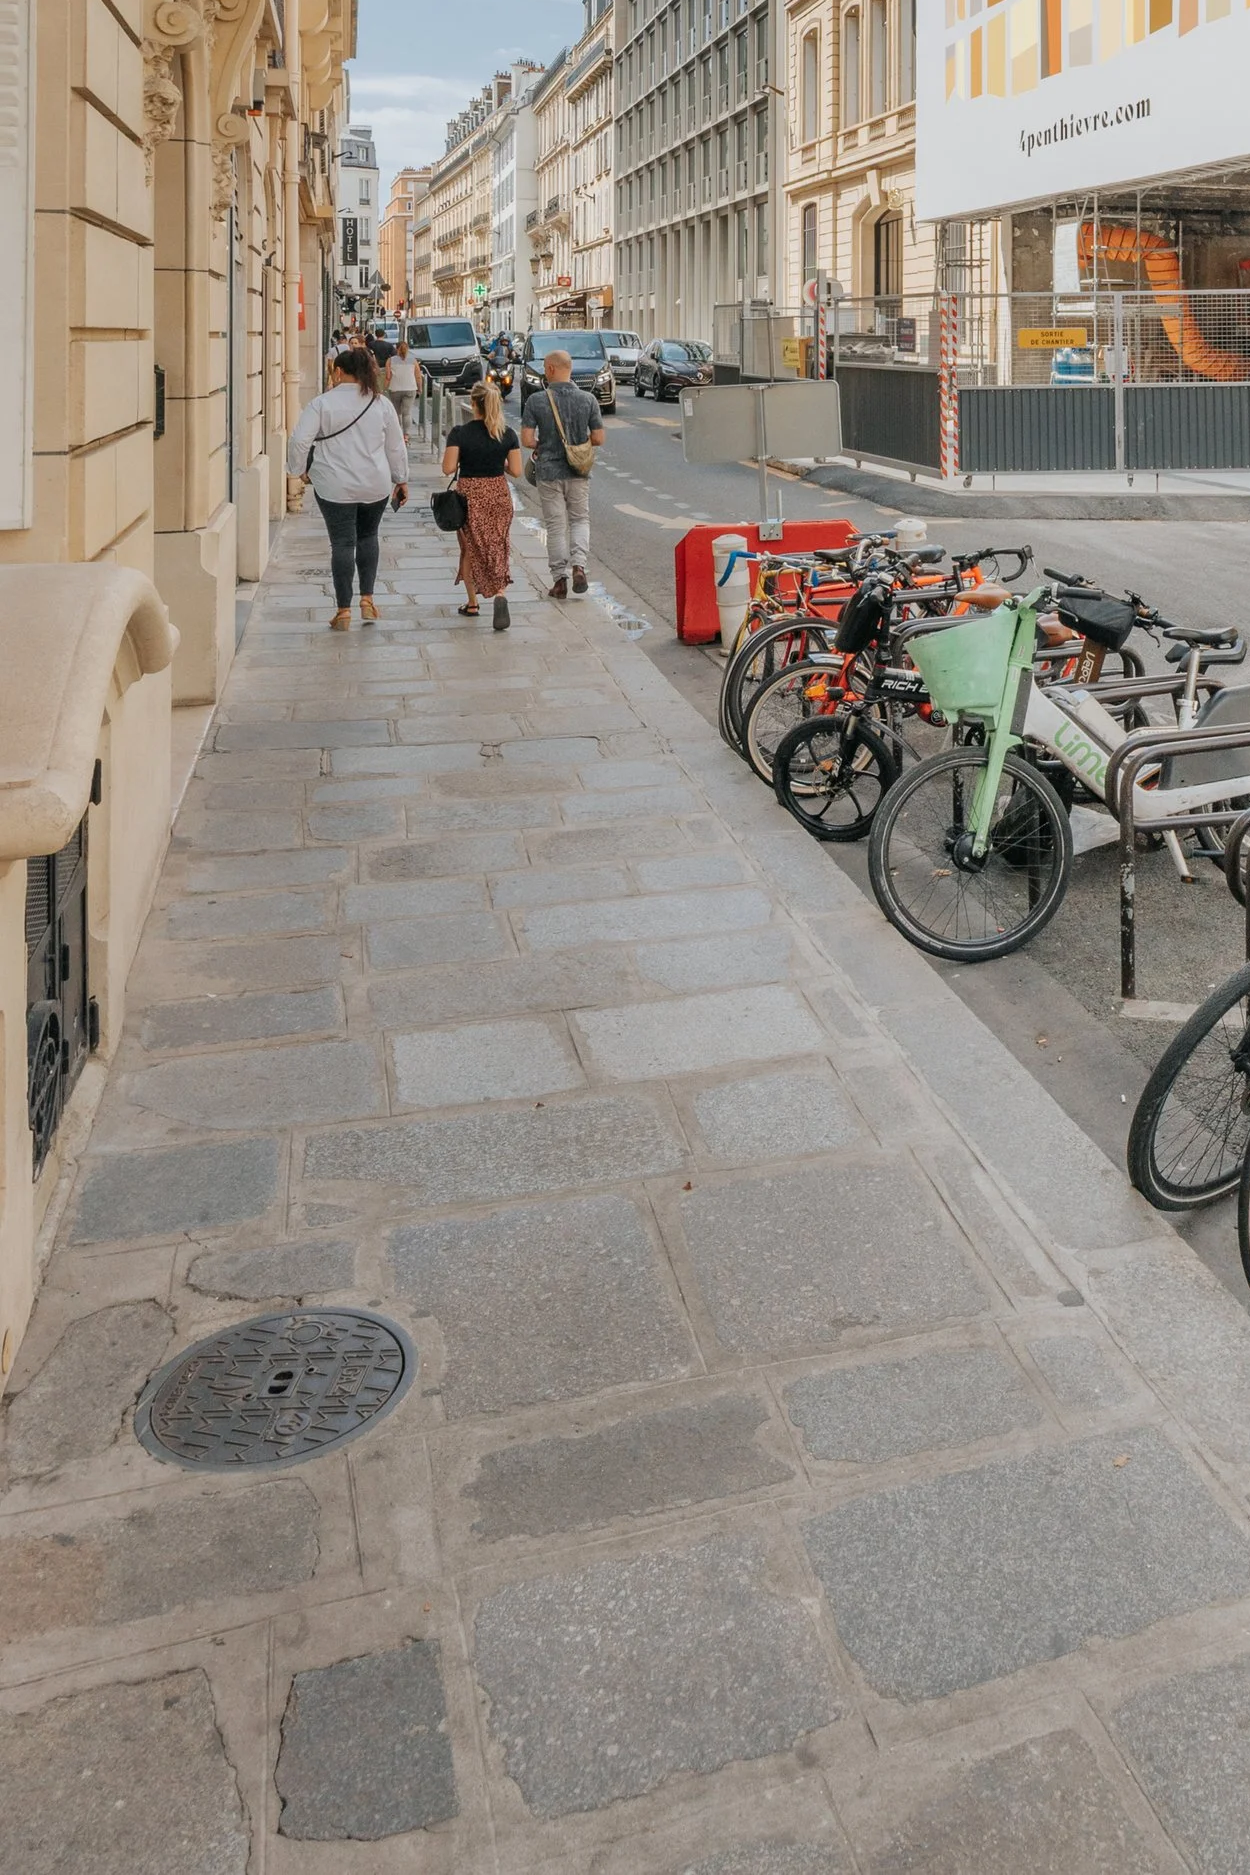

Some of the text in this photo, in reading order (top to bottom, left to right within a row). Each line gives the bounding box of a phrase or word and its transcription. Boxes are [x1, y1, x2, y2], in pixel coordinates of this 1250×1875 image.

[1019, 97, 1151, 157] 4penthievre.com
[346, 218, 354, 261] HOTEL
[880, 679, 919, 692] RICH
